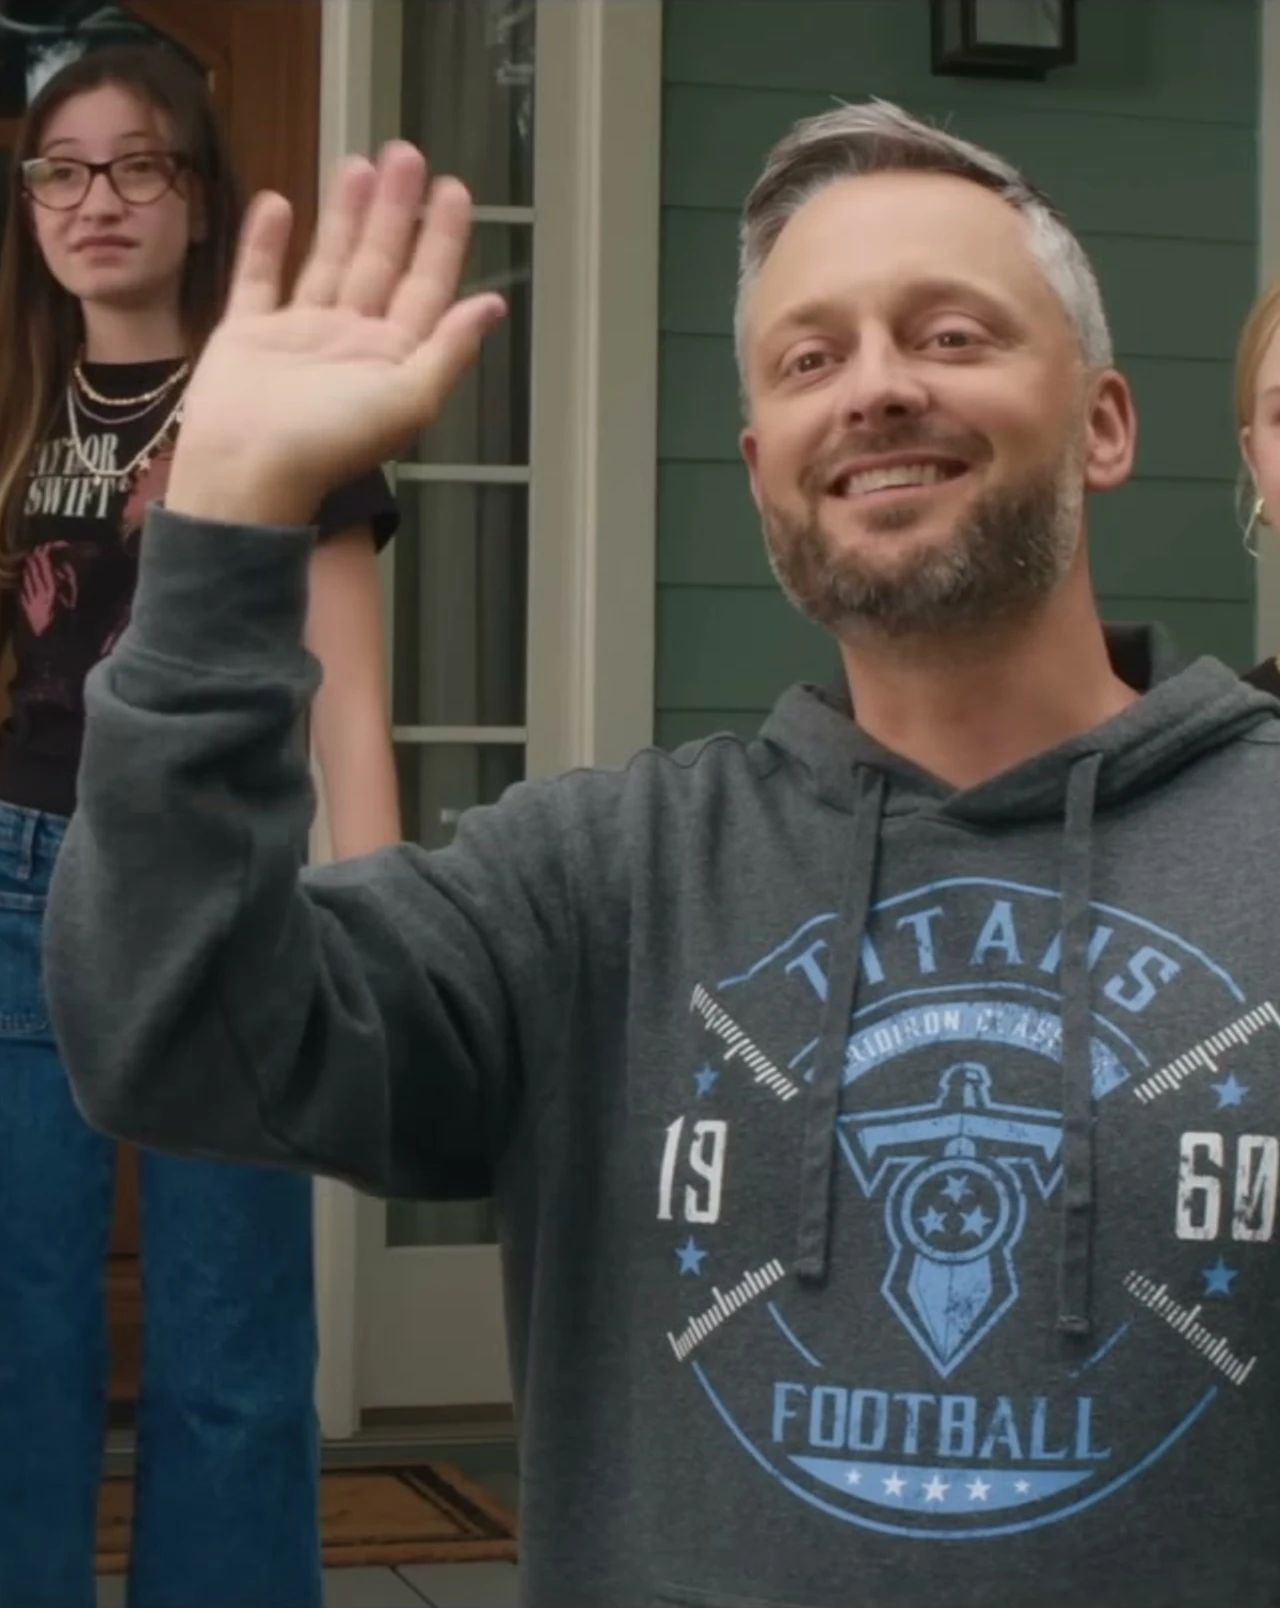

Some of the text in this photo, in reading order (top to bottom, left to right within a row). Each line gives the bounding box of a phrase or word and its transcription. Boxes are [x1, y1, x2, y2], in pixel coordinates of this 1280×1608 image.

[24, 476, 115, 518] SWIFT
[656, 1115, 728, 1224] 19
[1175, 1131, 1280, 1243] 60
[772, 1382, 1112, 1460] FOOTBALL
